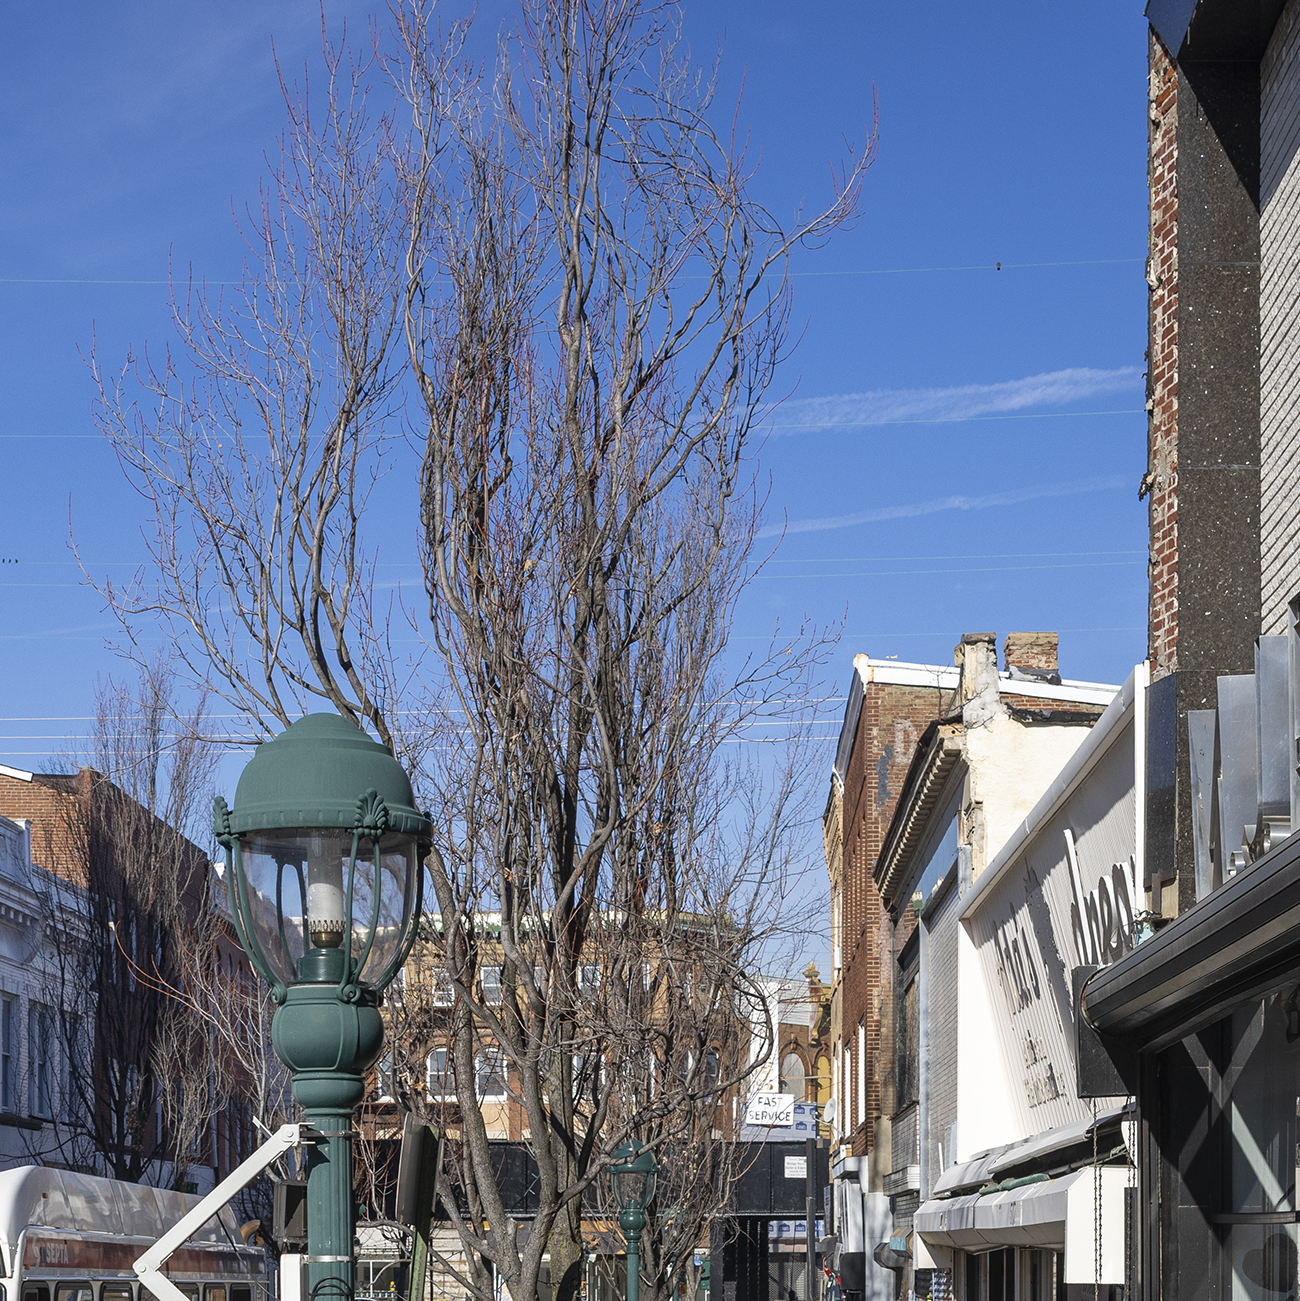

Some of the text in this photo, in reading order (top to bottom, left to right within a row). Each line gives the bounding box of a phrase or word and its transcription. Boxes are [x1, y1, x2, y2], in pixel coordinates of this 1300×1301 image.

[757, 1096, 784, 1108] FAST
[748, 1110, 792, 1122] SERVICE
[46, 1241, 69, 1264] SEPTA
